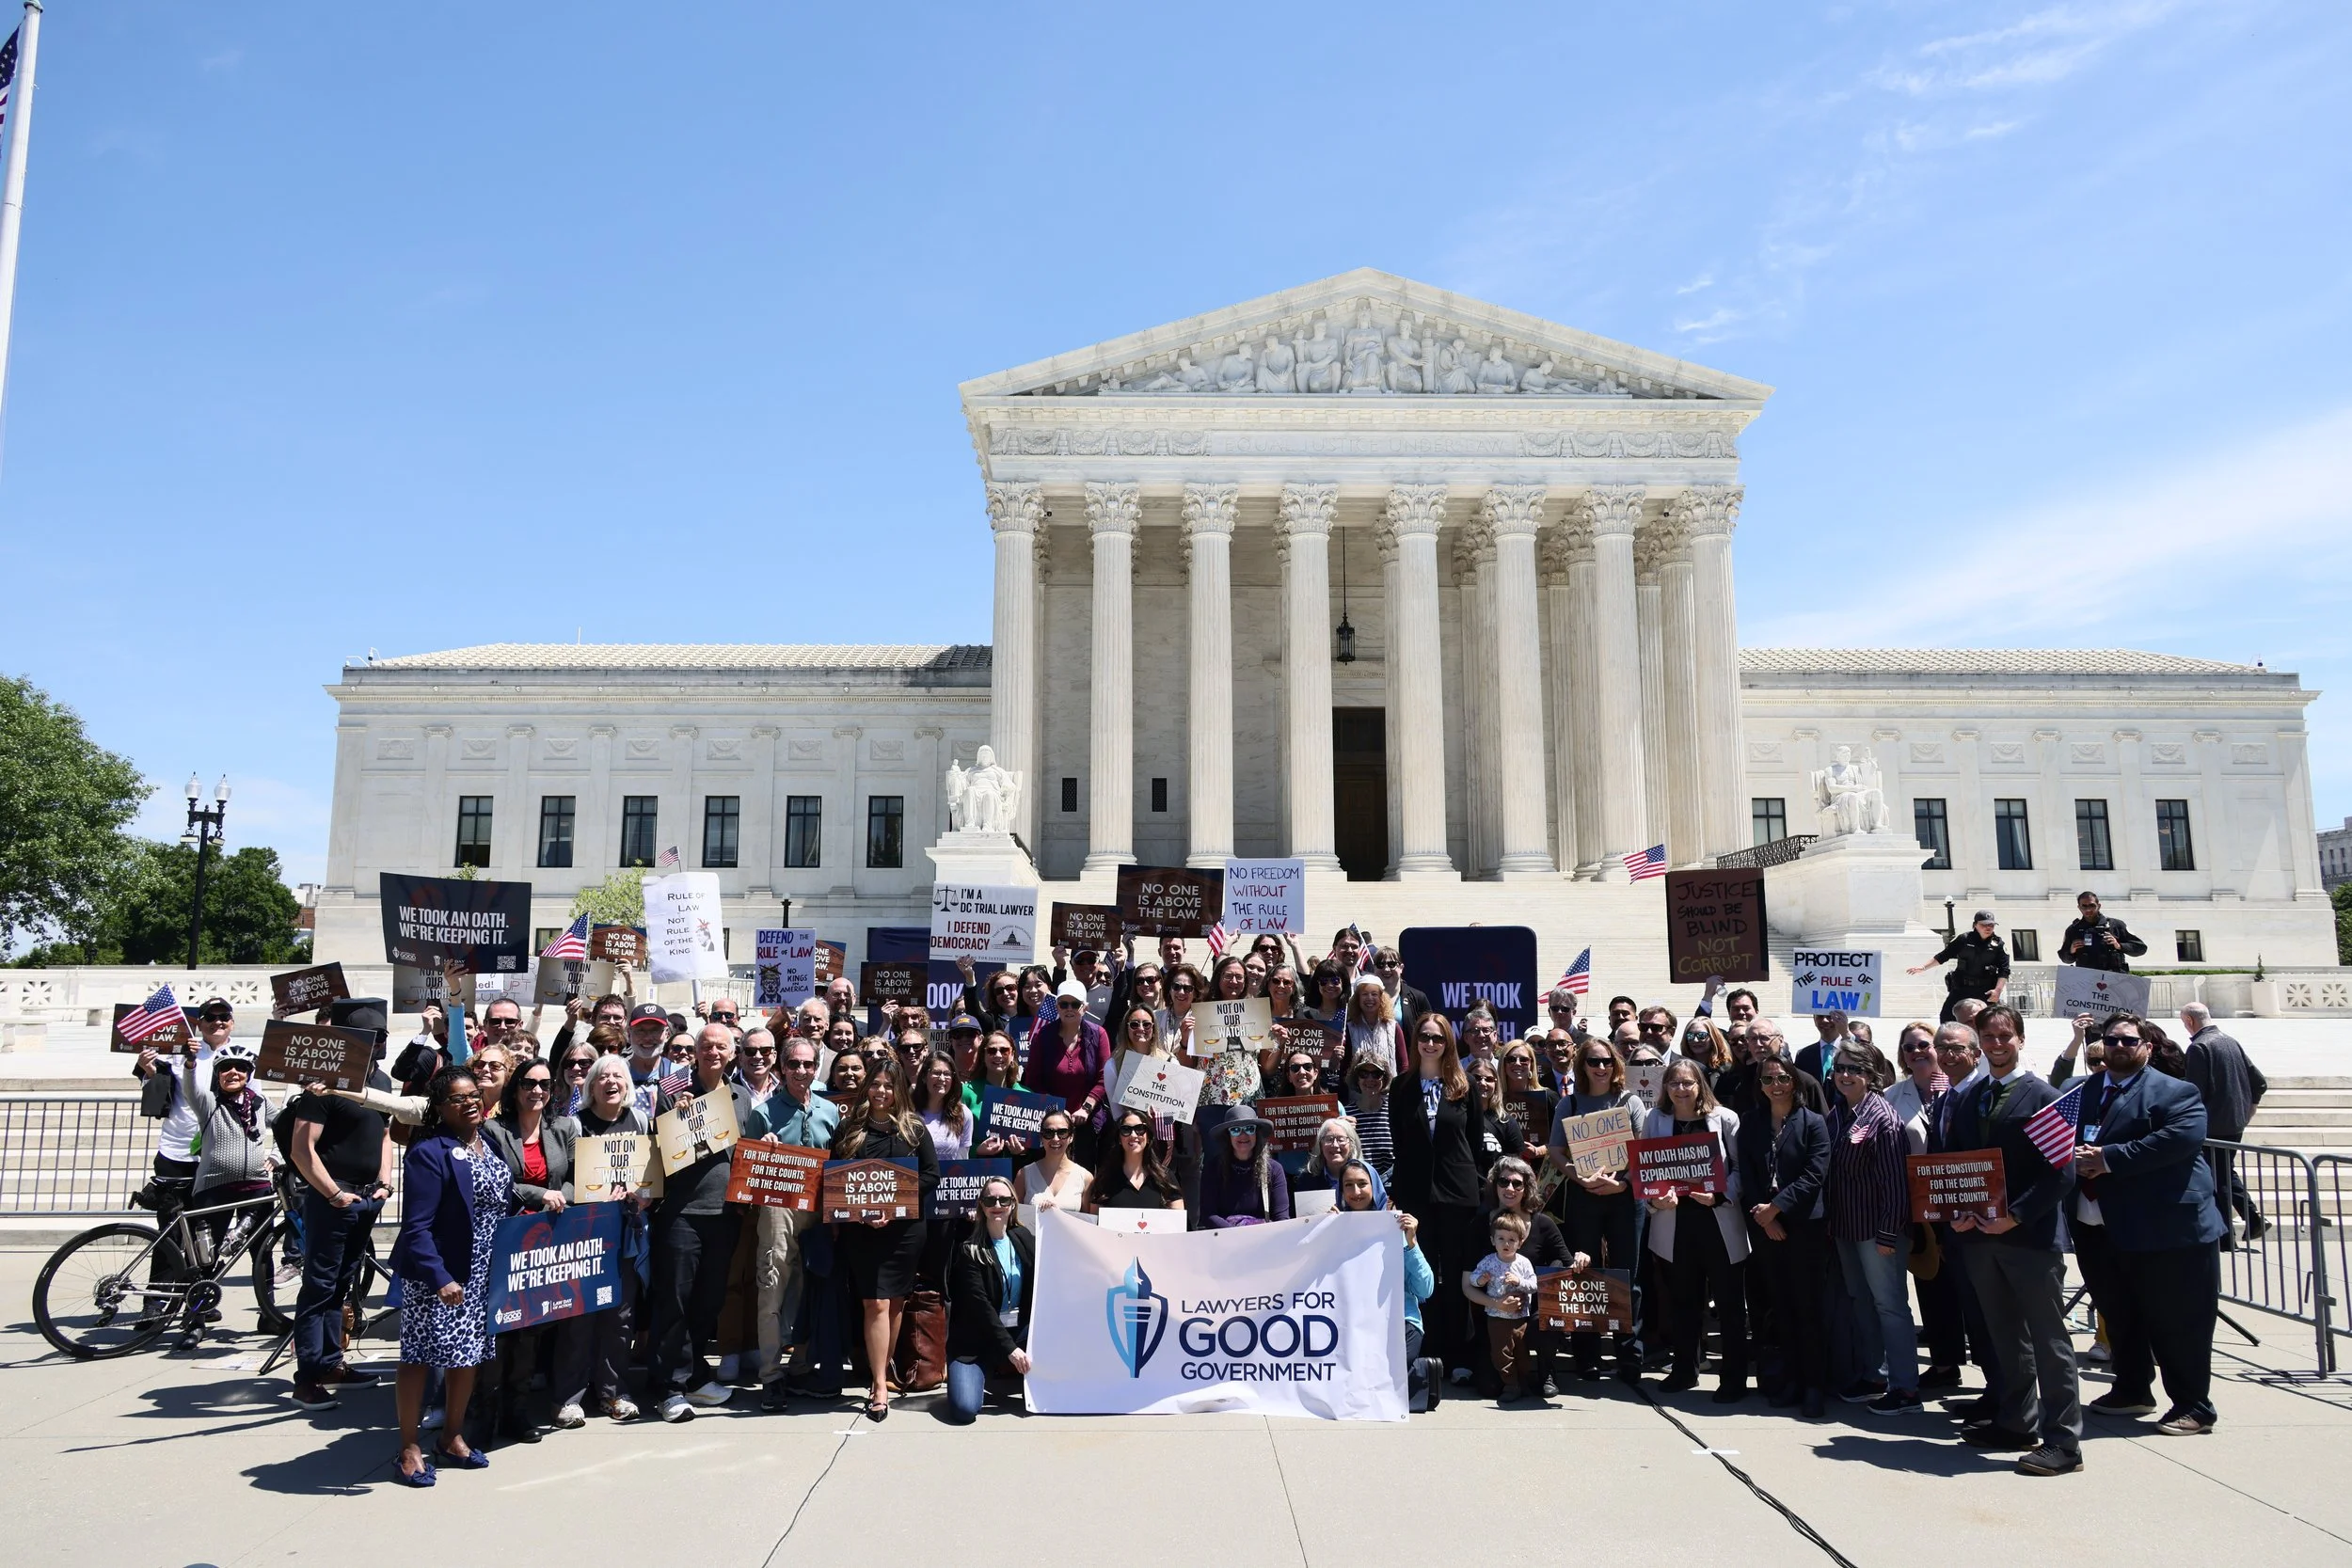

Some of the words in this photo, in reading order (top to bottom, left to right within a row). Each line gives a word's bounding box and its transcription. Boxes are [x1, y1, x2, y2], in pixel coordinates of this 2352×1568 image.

[1225, 436, 1289, 453] EQUAL
[1303, 436, 1378, 453] JUSTICE
[1389, 436, 1454, 453] UNDER
[1467, 436, 1504, 453] LAW
[1230, 867, 1247, 879] NO
[1251, 867, 1299, 879] FREEDOM
[961, 889, 974, 899] I'M
[977, 890, 982, 899] A
[1142, 883, 1164, 894] NO
[1169, 884, 1199, 895] ONE
[1232, 885, 1287, 897] WITHOUT
[1676, 880, 1756, 900] JUSTICE
[1138, 895, 1150, 905] IS
[1154, 896, 1201, 907] ABOVE
[961, 903, 972, 912] DC
[975, 903, 997, 914] TRIAL
[1000, 905, 1034, 916] LAWYER
[1138, 907, 1163, 918] THE
[1169, 909, 1200, 920] LAW.
[1232, 902, 1254, 914] THE
[1259, 904, 1287, 915] RULE
[1677, 906, 1716, 918] SHOULD
[1724, 903, 1742, 914] BE
[399, 906, 416, 922] WE
[418, 909, 450, 927] TOOK
[451, 911, 469, 927] AN
[472, 912, 509, 927] OATH.
[1240, 919, 1254, 929] OF
[1259, 917, 1287, 929] LAW
[399, 923, 434, 942] WE'RE
[437, 927, 489, 944] KEEPING
[493, 930, 507, 944] IT.
[948, 921, 950, 932] I
[954, 922, 990, 934] DEFEND
[1686, 919, 1748, 937] BLIND
[759, 930, 794, 943] DEFEND
[930, 936, 990, 950] DEMOCRACY
[757, 946, 778, 959] RULE
[790, 946, 814, 958] LAW
[1698, 936, 1740, 955] NOT
[1678, 954, 1754, 974] CORRUPT
[1795, 952, 1873, 967] PROTECT
[1794, 971, 1817, 988] THE
[1821, 976, 1852, 986] RULE
[1858, 974, 1873, 985] OF
[1442, 983, 1470, 1008] WE
[1473, 983, 1522, 1008] TOOK
[2092, 991, 2109, 1001] THE
[1216, 1003, 1232, 1014] NOT
[1233, 1003, 1245, 1013] ON
[1224, 1014, 1240, 1024] OUR
[1217, 1026, 1248, 1037] WATCH.
[292, 1036, 312, 1046] NO
[317, 1038, 345, 1049] ONE
[285, 1046, 296, 1055] IS
[300, 1049, 345, 1061] ABOVE
[284, 1057, 309, 1069] THE
[312, 1061, 341, 1072] LAW.
[1152, 1082, 1167, 1091] THE
[1127, 1086, 1184, 1108] CONSTITUTION
[696, 1099, 707, 1114] ON
[688, 1115, 705, 1130] OUR
[1572, 1122, 1589, 1141] NO
[1597, 1113, 1625, 1134] ONE
[683, 1128, 714, 1148] WATCH.
[604, 1141, 623, 1153] NOT
[624, 1140, 635, 1151] ON
[1486, 1142, 1502, 1152] DC
[612, 1155, 629, 1167] OUR
[743, 1149, 757, 1159] FOR
[758, 1151, 771, 1162] THE
[771, 1154, 818, 1168] CONSTITUTION.
[1576, 1151, 1600, 1171] THE
[1639, 1151, 1654, 1164] MY
[1654, 1148, 1675, 1164] OATH
[1677, 1147, 1695, 1160] HAS
[1696, 1146, 1709, 1158] NO
[752, 1164, 766, 1174] FOR
[766, 1166, 778, 1176] THE
[778, 1168, 805, 1180] COURTS.
[1640, 1165, 1692, 1181] EXPIRATION
[1692, 1164, 1714, 1178] DATE.
[1917, 1166, 1931, 1176] FOR
[1932, 1165, 1945, 1175] THE
[1947, 1161, 1994, 1174] CONSTITUTION.
[602, 1169, 637, 1183] WATCH.
[849, 1172, 866, 1181] NO
[870, 1171, 894, 1180] ONE
[1930, 1180, 1944, 1189] FOR
[1945, 1179, 1958, 1188] THE
[1960, 1177, 1987, 1187] COURTS.
[746, 1179, 759, 1188] FOR
[760, 1180, 773, 1190] THE
[774, 1181, 805, 1194] COUNTRY.
[846, 1183, 855, 1193] IS
[859, 1182, 897, 1192] ABOVE
[846, 1195, 866, 1204] THE
[871, 1194, 897, 1203] LAW.
[1930, 1195, 1943, 1204] FOR
[1945, 1194, 1957, 1203] THE
[1959, 1192, 1991, 1202] COUNTRY.
[510, 1251, 528, 1272] WE
[529, 1245, 557, 1268] TOOK
[558, 1243, 575, 1262] AN
[576, 1238, 606, 1259] OATH.
[508, 1268, 544, 1292] WE'RE
[545, 1259, 591, 1285] KEEPING
[593, 1257, 604, 1275] IT.
[1561, 1280, 1577, 1291] NO
[1581, 1281, 1605, 1291] ONE
[1182, 1293, 1284, 1314] LAWYERS
[1292, 1291, 1335, 1309] FOR
[1559, 1292, 1567, 1302] IS
[1571, 1292, 1609, 1303] ABOVE
[1559, 1304, 1579, 1313] THE
[1582, 1305, 1609, 1314] LAW.
[1179, 1315, 1339, 1357] GOOD
[1181, 1362, 1336, 1381] GOVERNMENT
